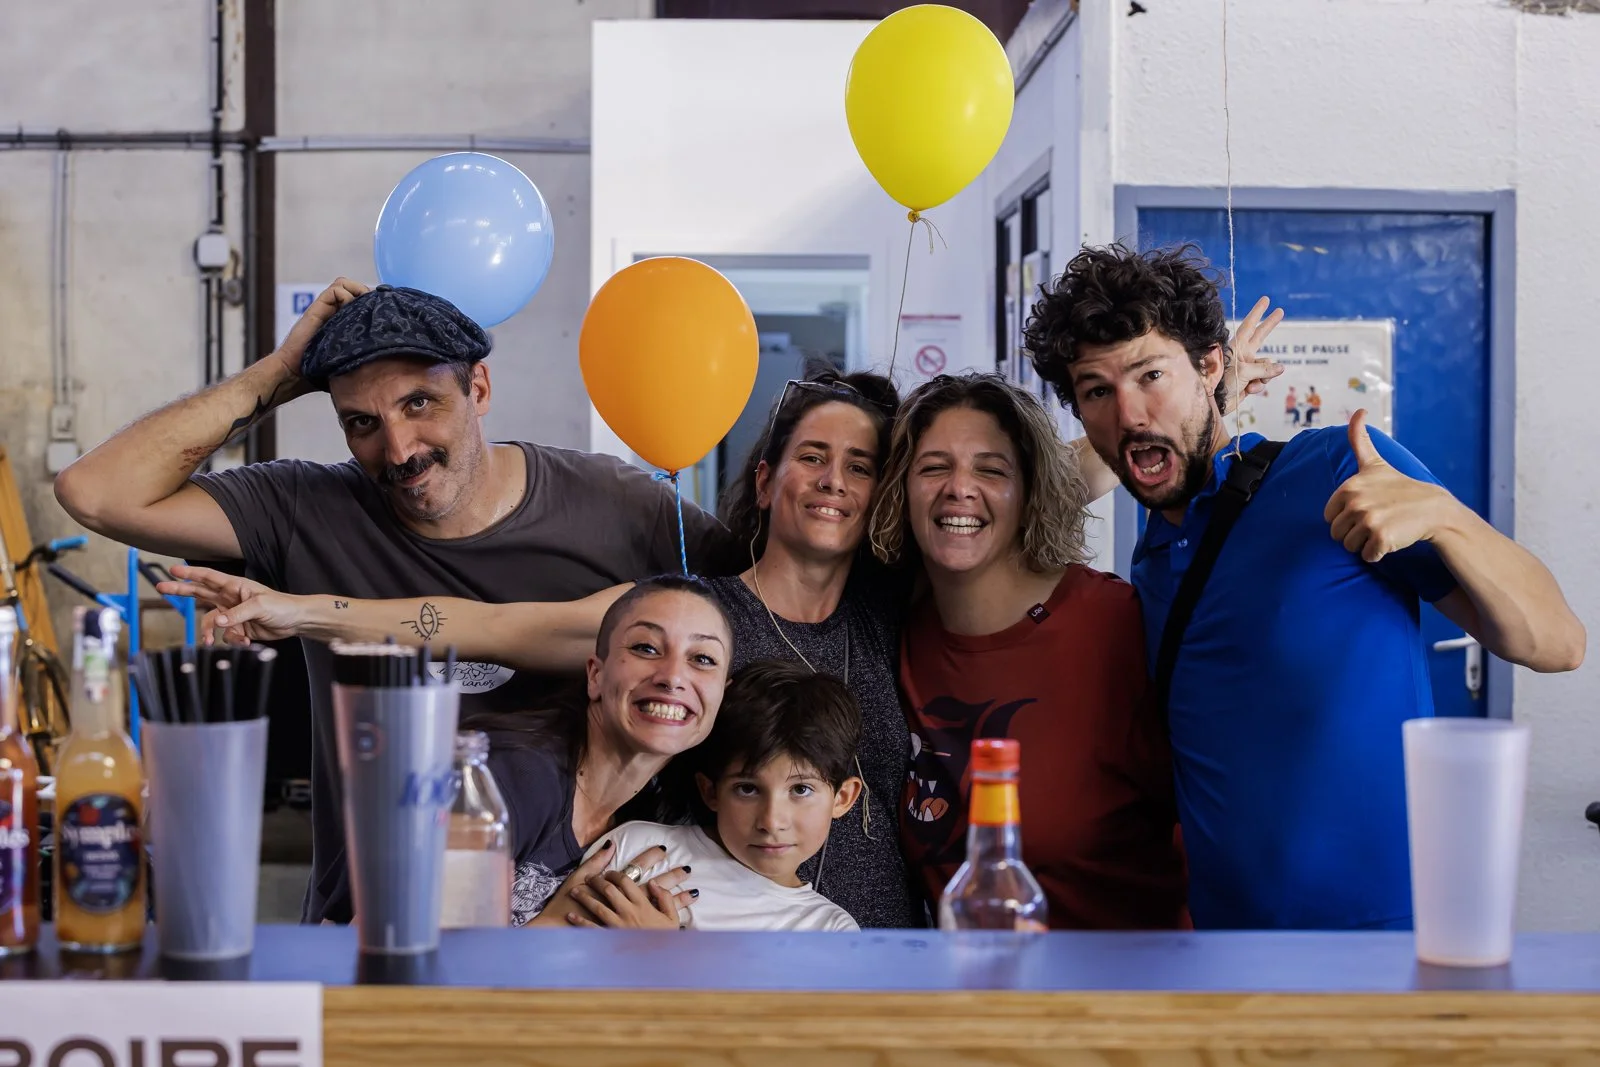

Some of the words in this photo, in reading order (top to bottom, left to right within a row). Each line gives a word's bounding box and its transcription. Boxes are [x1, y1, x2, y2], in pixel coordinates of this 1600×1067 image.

[1293, 344, 1306, 354] DE
[1312, 344, 1350, 354] PAUSE
[334, 600, 349, 610] EW
